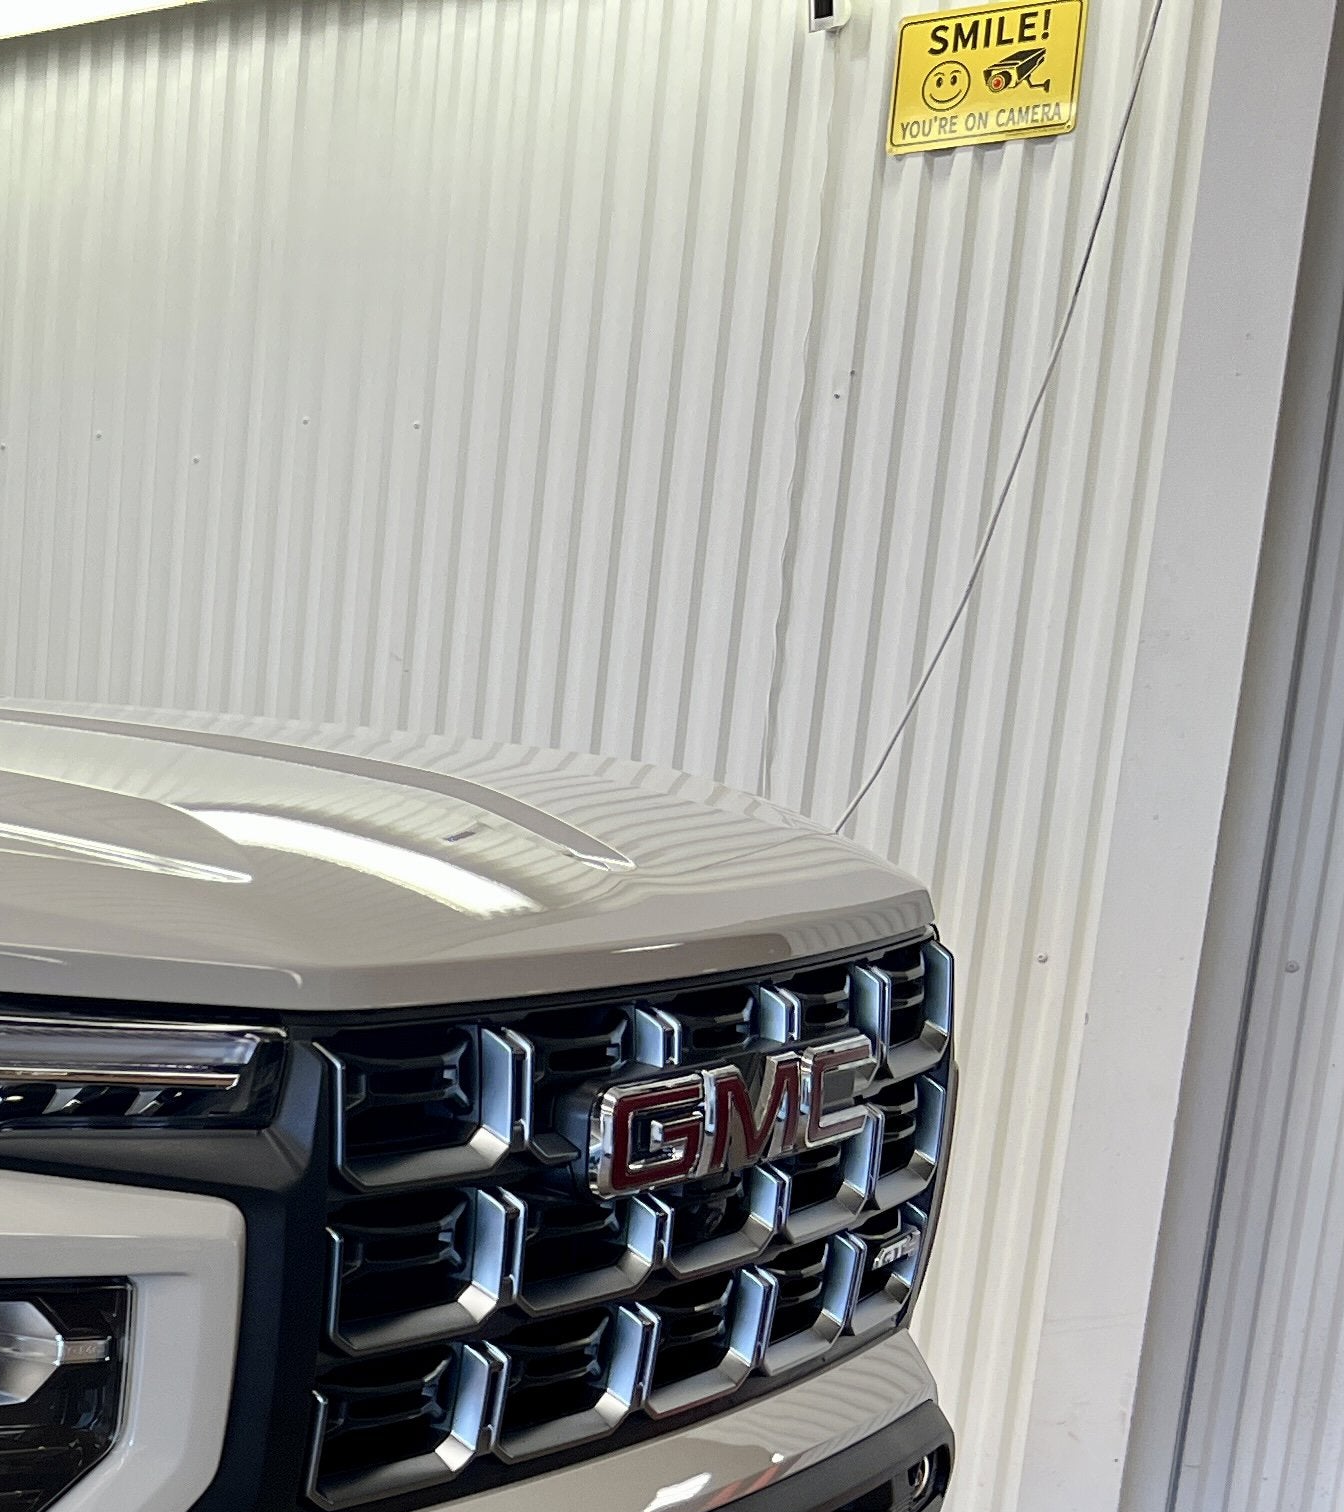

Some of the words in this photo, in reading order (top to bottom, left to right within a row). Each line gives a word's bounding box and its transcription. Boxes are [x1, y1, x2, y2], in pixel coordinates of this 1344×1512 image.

[928, 9, 1051, 55] SMILE!
[900, 115, 959, 141] YOU'RE
[964, 111, 989, 131] ON
[994, 102, 1062, 128] CAMERA
[590, 1034, 878, 1199] GMC
